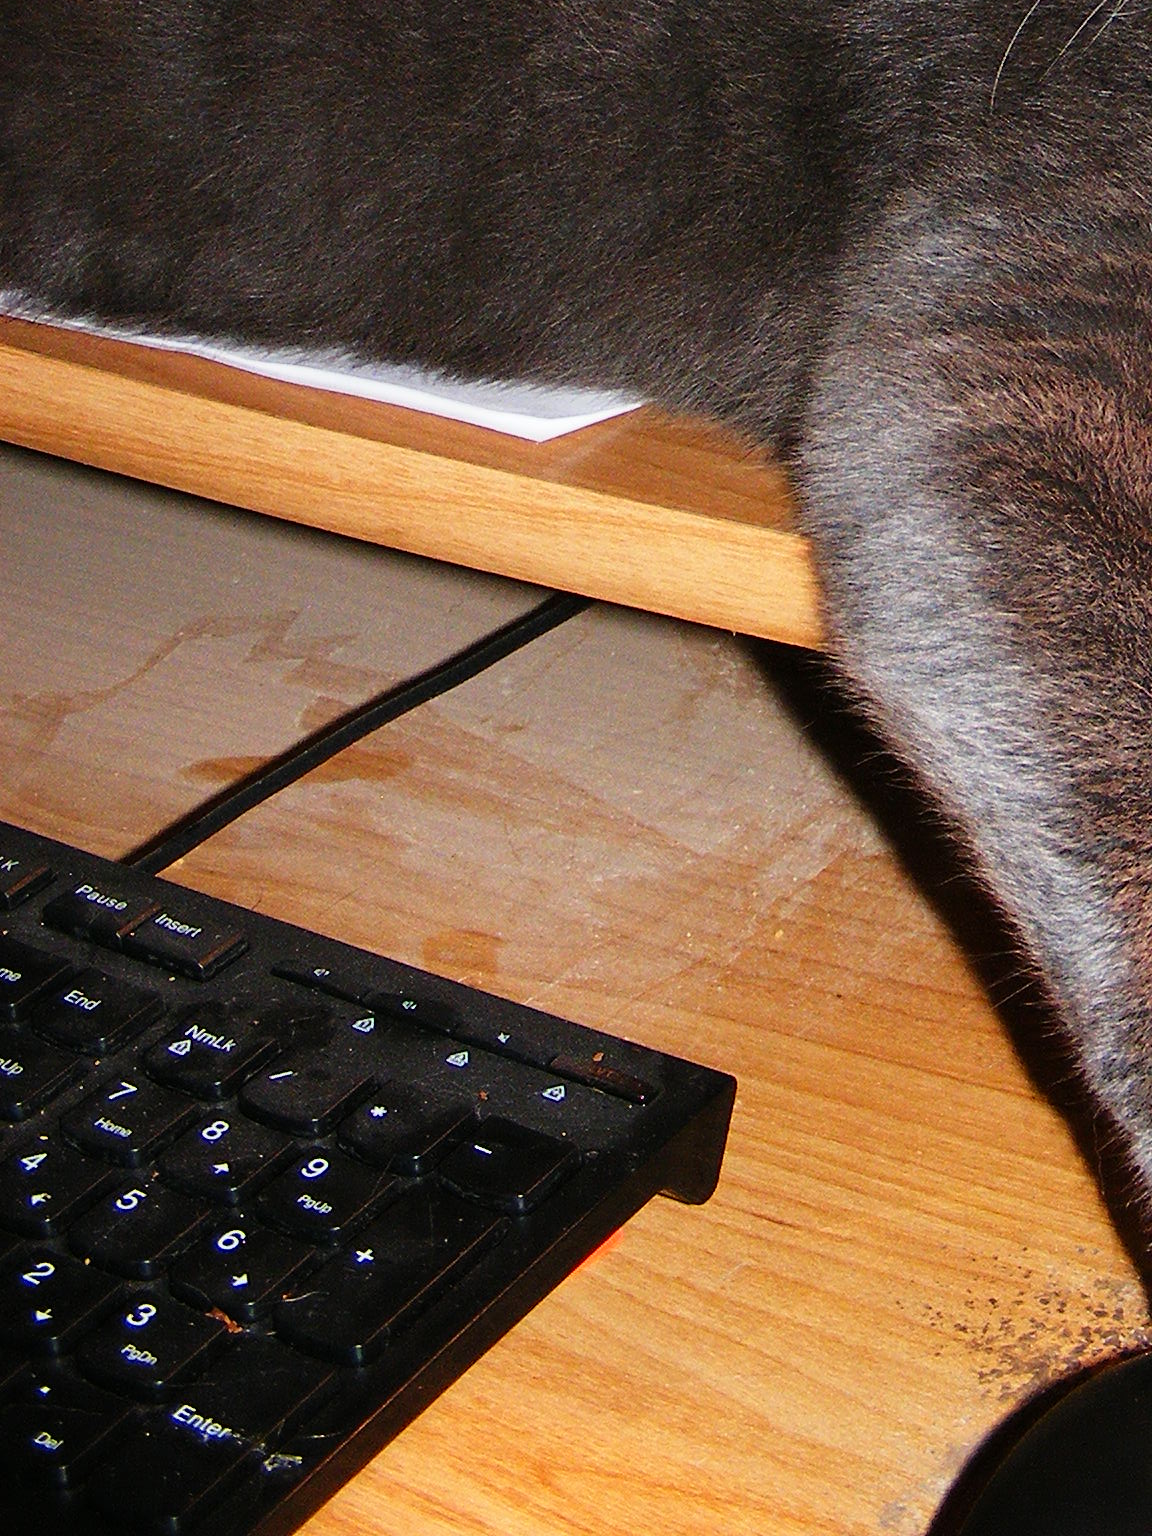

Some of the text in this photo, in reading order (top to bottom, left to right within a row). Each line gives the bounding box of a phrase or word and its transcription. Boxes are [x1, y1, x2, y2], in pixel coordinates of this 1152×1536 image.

[75, 884, 128, 912] Pause
[155, 913, 202, 938] Insert
[63, 989, 102, 1011] End
[184, 1024, 238, 1053] NmLk
[108, 1081, 138, 1100] 7
[94, 1117, 133, 1139] Home
[201, 1120, 231, 1142] 8
[20, 1152, 48, 1172] 4
[300, 1158, 330, 1179] 9
[115, 1188, 147, 1211] 5
[296, 1194, 333, 1215] PgUp
[216, 1229, 247, 1252] 6
[22, 1261, 56, 1286] 2
[126, 1303, 157, 1327] 3
[120, 1344, 158, 1366] PgDn
[172, 1404, 233, 1439] Enter
